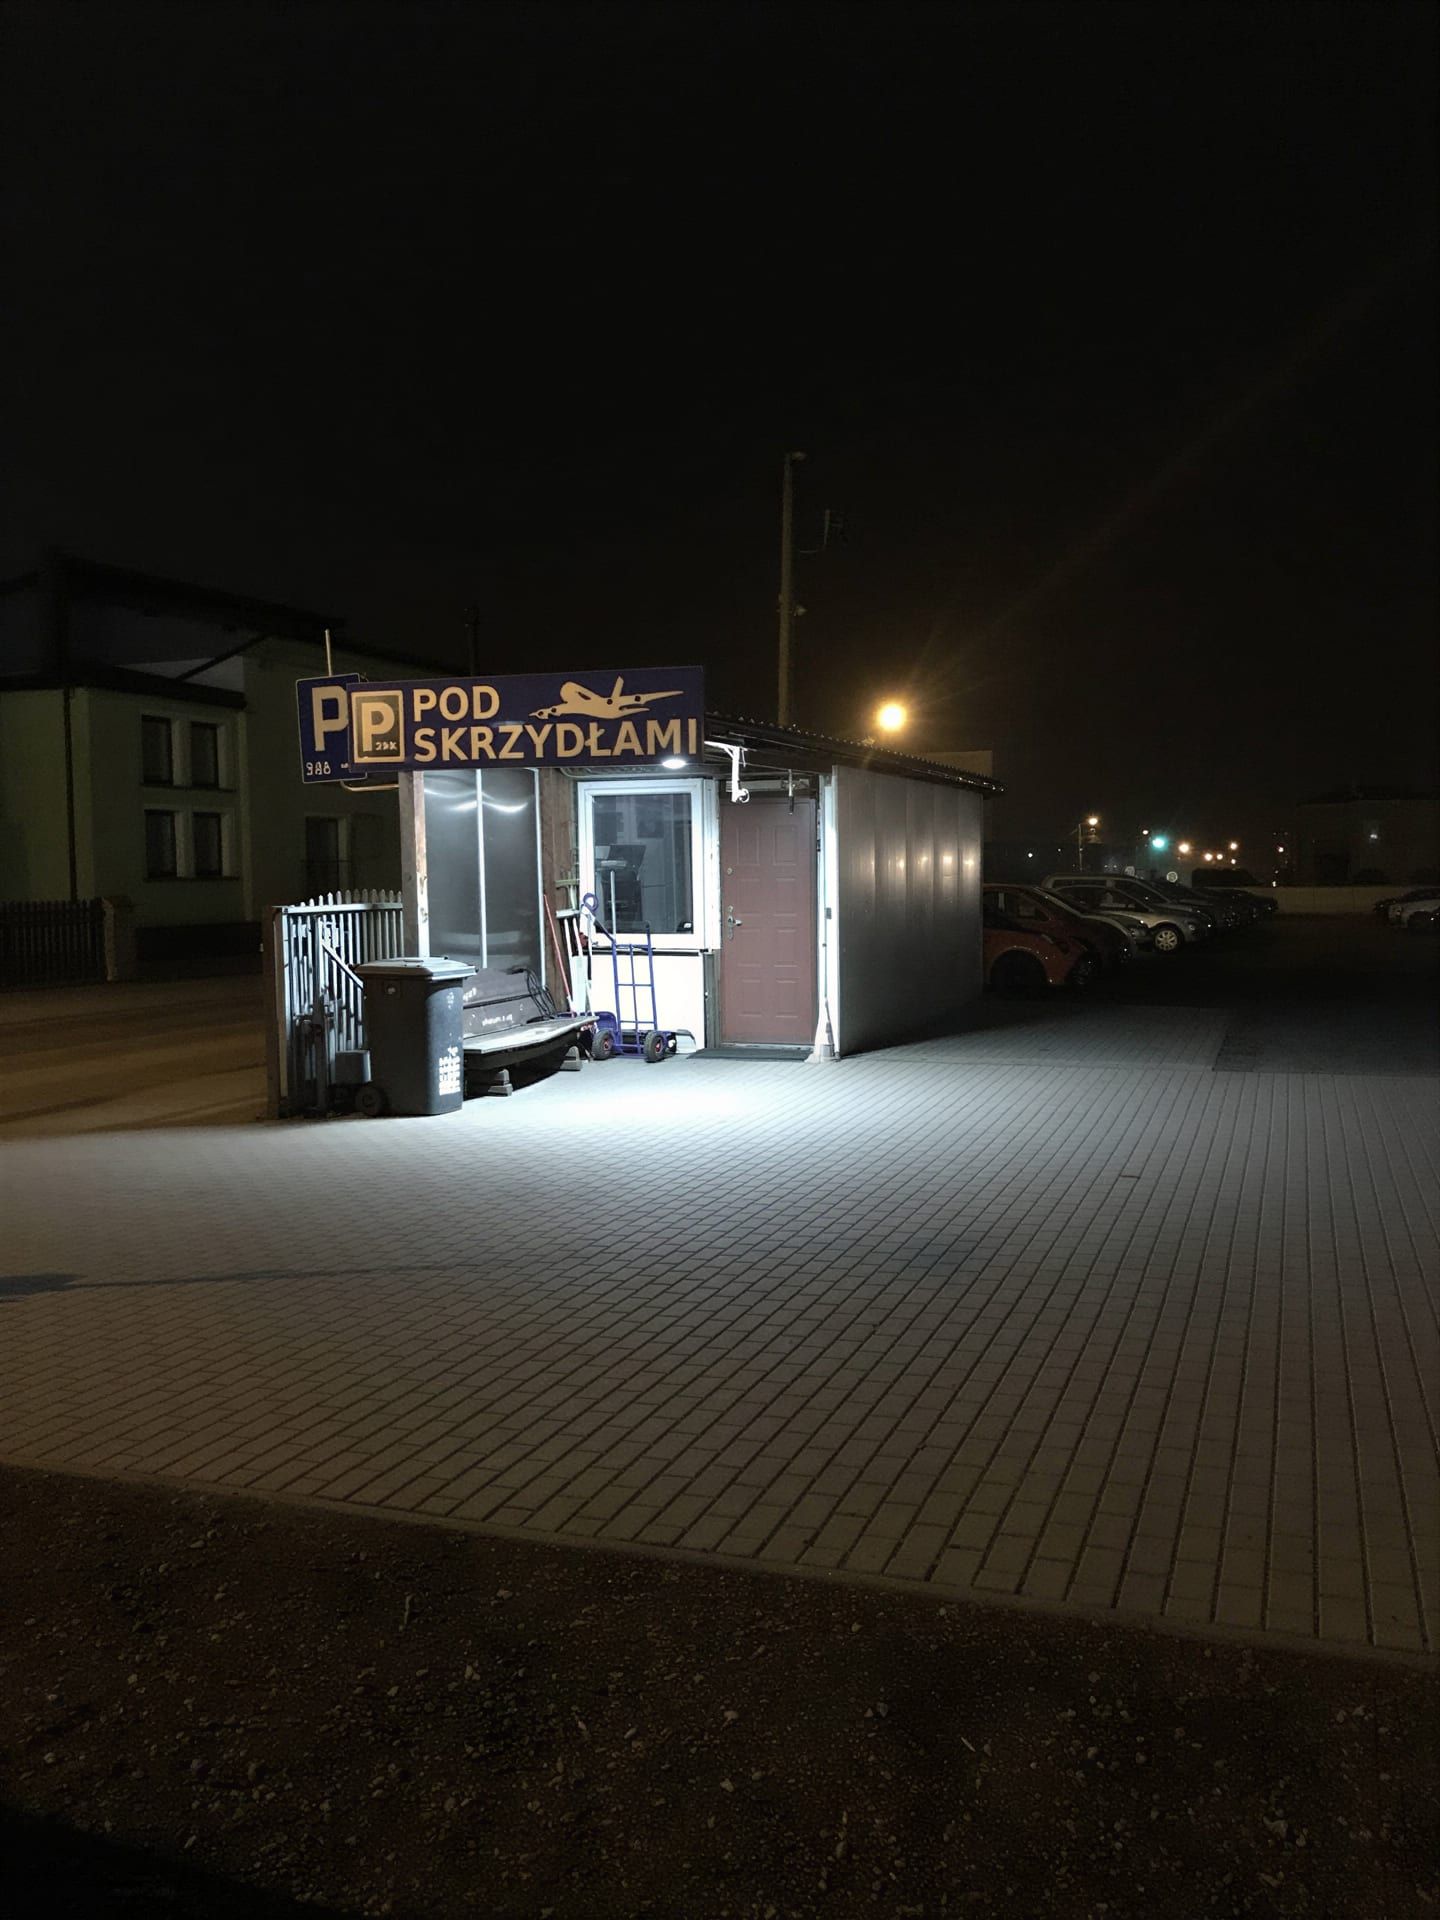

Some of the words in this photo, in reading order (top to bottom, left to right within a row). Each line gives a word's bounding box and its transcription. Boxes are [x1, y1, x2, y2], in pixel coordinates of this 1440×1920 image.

[312, 686, 349, 752] P
[361, 701, 395, 753] P
[412, 685, 500, 723] POD
[413, 717, 698, 763] SKRZYDŁAMI
